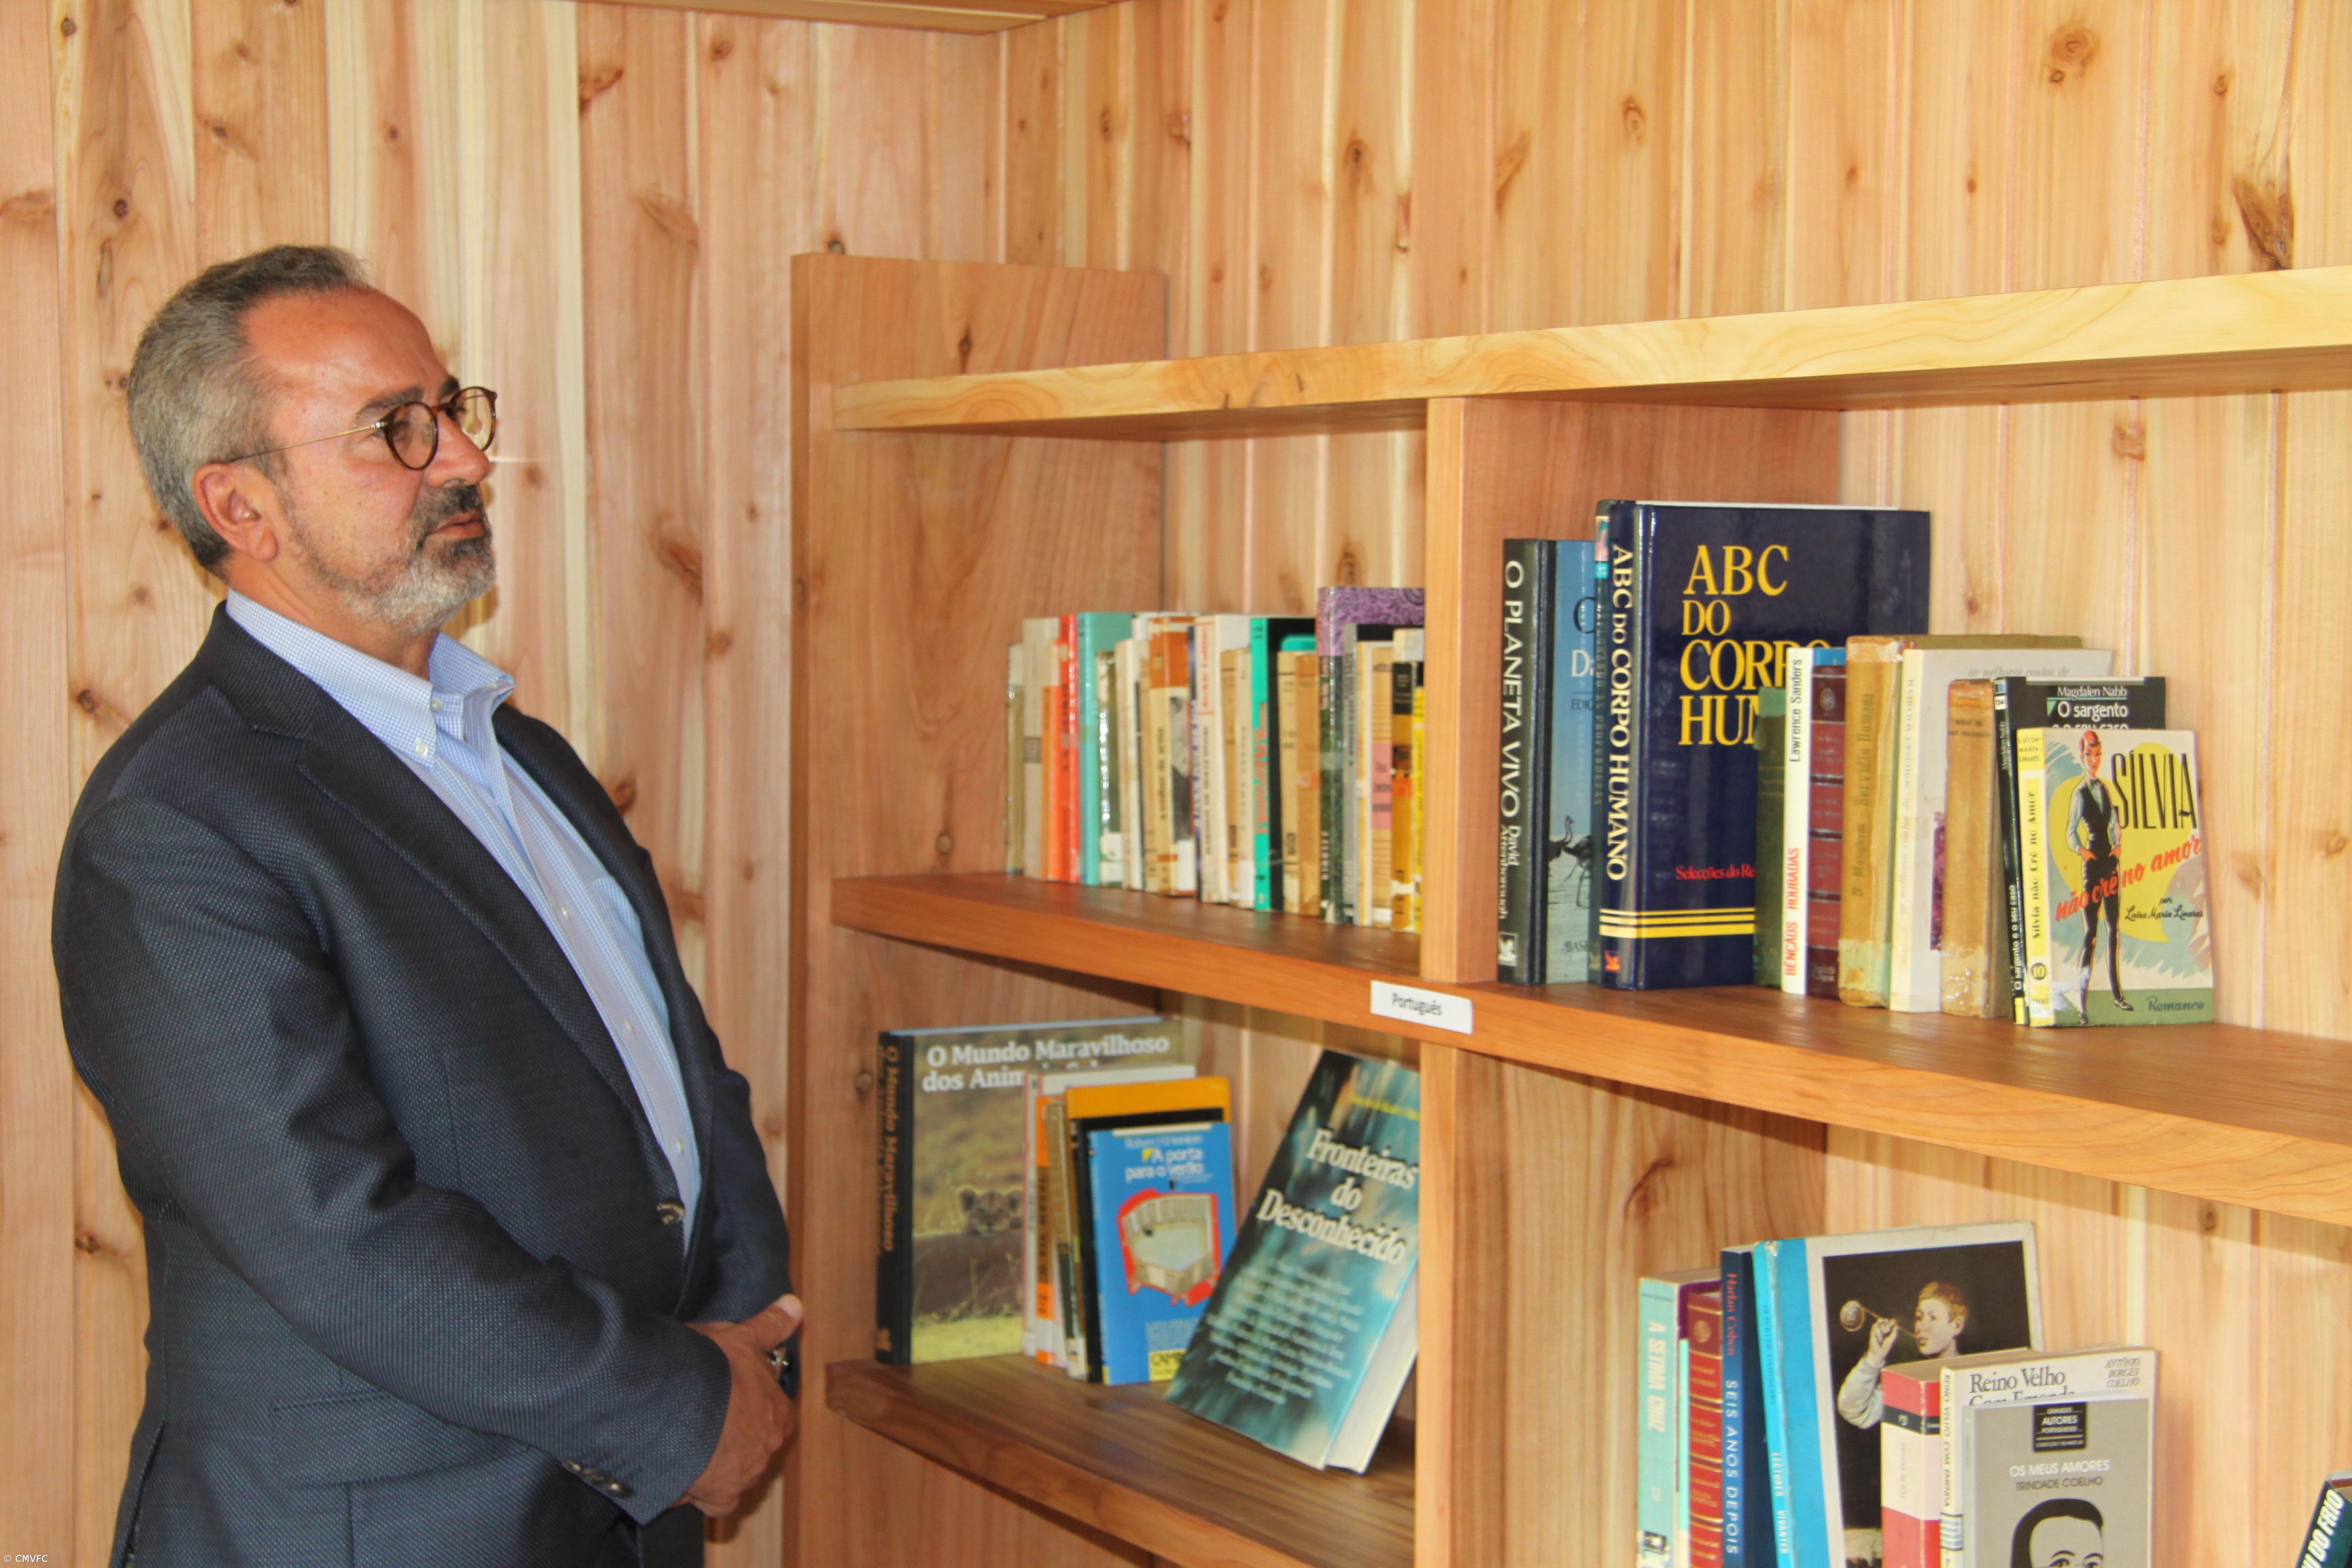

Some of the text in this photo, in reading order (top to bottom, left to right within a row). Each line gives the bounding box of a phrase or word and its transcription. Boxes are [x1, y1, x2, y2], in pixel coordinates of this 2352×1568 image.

[1683, 544, 1789, 596] ABC
[1681, 599, 1731, 636] DO
[1680, 639, 1831, 690] CORP
[1500, 560, 1524, 819] O PLANETA VIVO
[2057, 686, 2127, 700] Magdalen Nabb
[1606, 543, 1633, 881] ABC DO CORPO HUMANO
[1789, 659, 1802, 763] Lawrence Sanders
[2058, 700, 2128, 722] O sargento
[2110, 748, 2197, 829] SÍLVIA
[1507, 826, 1522, 866] David
[1675, 865, 1725, 881] Selecções
[1725, 863, 1740, 879] do
[2055, 835, 2202, 922] não crê no amor
[2009, 884, 2017, 906] caso
[2158, 896, 2173, 906] por
[2009, 907, 2018, 923] seu
[2124, 904, 2204, 922] Luisa Maria Linares
[1392, 992, 1442, 1016] Português
[2146, 995, 2204, 1012] Romance
[927, 1033, 1172, 1068] O Mundo Maravilhoso
[922, 1071, 965, 1092] dos
[882, 1045, 900, 1252] O Mundo Maravilhoso
[1165, 1147, 1204, 1168] porta
[1305, 1127, 1420, 1190] Fronteiras
[1125, 1166, 1155, 1184] para
[1330, 1176, 1363, 1210] do
[1256, 1188, 1407, 1265] Desconhecido
[1648, 1321, 1666, 1332] A
[1726, 1273, 1738, 1356] Harlan Coben
[1969, 1365, 2066, 1394] Reino Velho
[2106, 1377, 2140, 1388] COELHO
[2107, 1368, 2139, 1378] BORGES
[1647, 1395, 1666, 1432] CRUZ
[2041, 1414, 2079, 1426] AUTORES
[1725, 1379, 1739, 1554] SEIS ANOS DEPOIS
[2009, 1460, 2111, 1477] OS MEUS AMORES
[2016, 1476, 2104, 1491] TRINDADE COELHO
[2316, 1488, 2345, 1536] FRIO
[2306, 1528, 2331, 1562] DO
